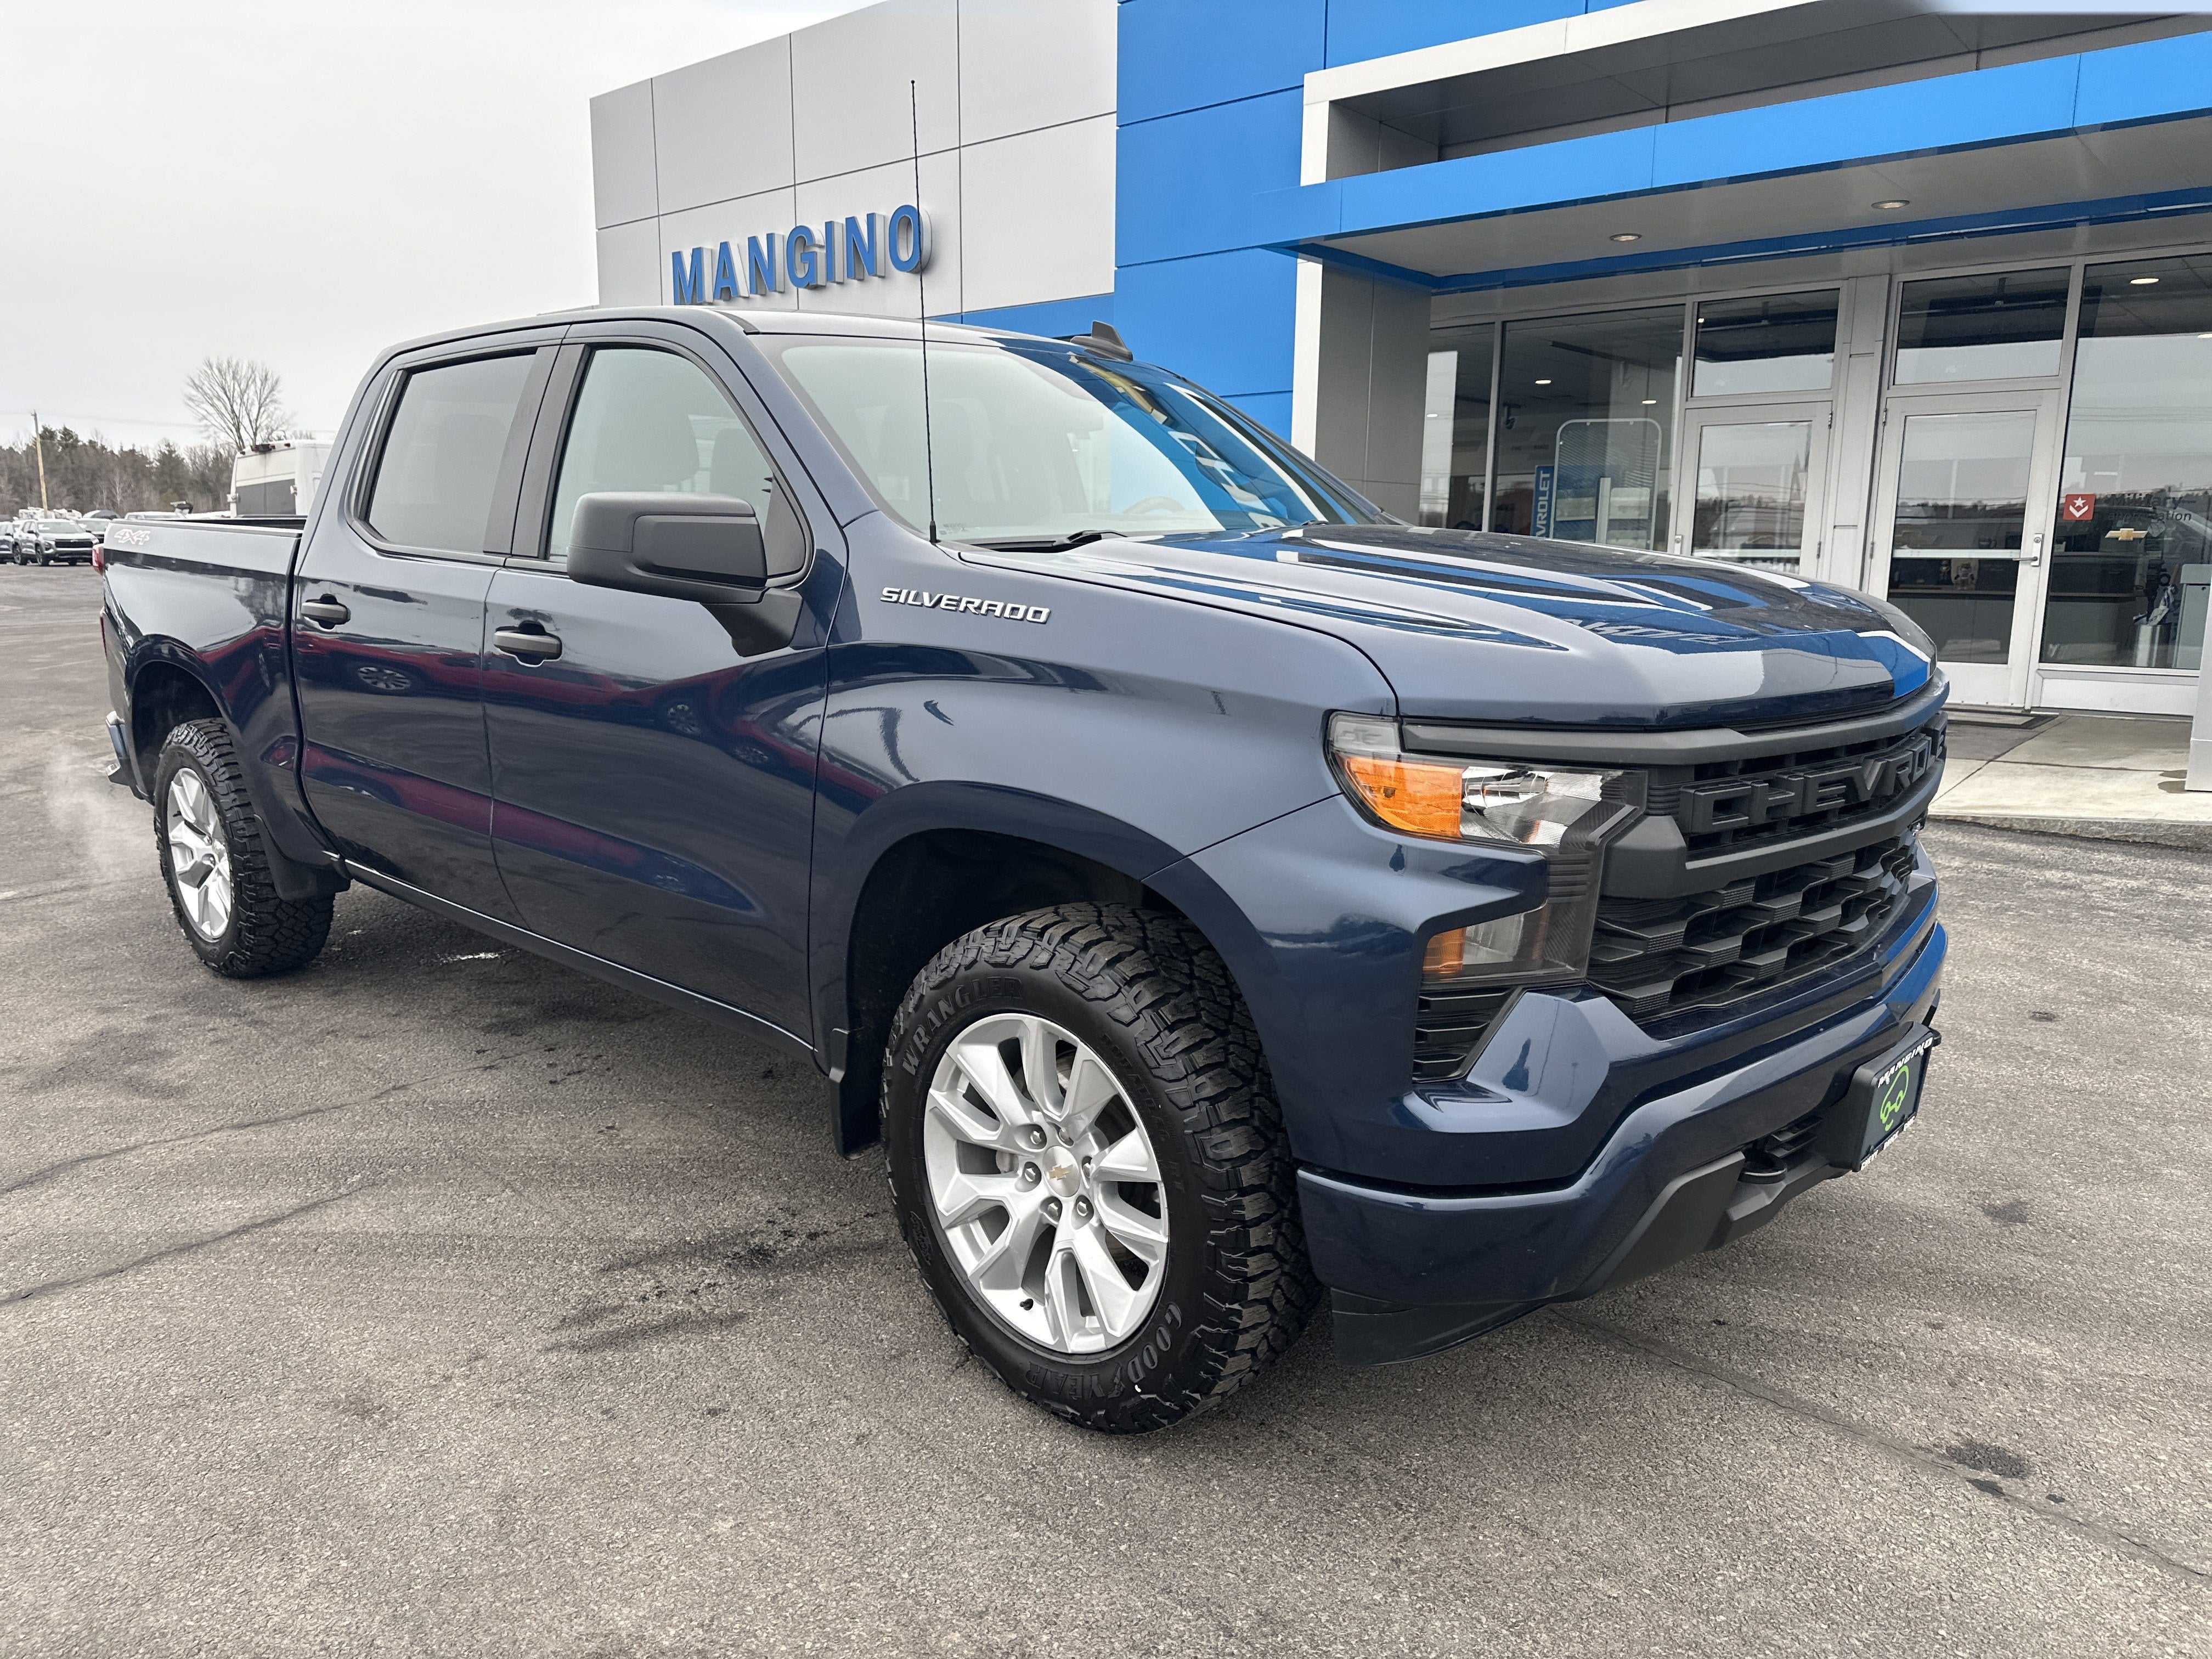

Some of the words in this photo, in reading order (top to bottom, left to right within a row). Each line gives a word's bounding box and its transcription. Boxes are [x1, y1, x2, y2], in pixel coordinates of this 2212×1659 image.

[672, 204, 927, 306] MANGINO
[880, 587, 1051, 624] SILVERADO
[1680, 712, 1948, 834] CHEVROLE
[901, 976, 1023, 1076] WRANGLER
[1877, 1037, 1933, 1088] MANGINO
